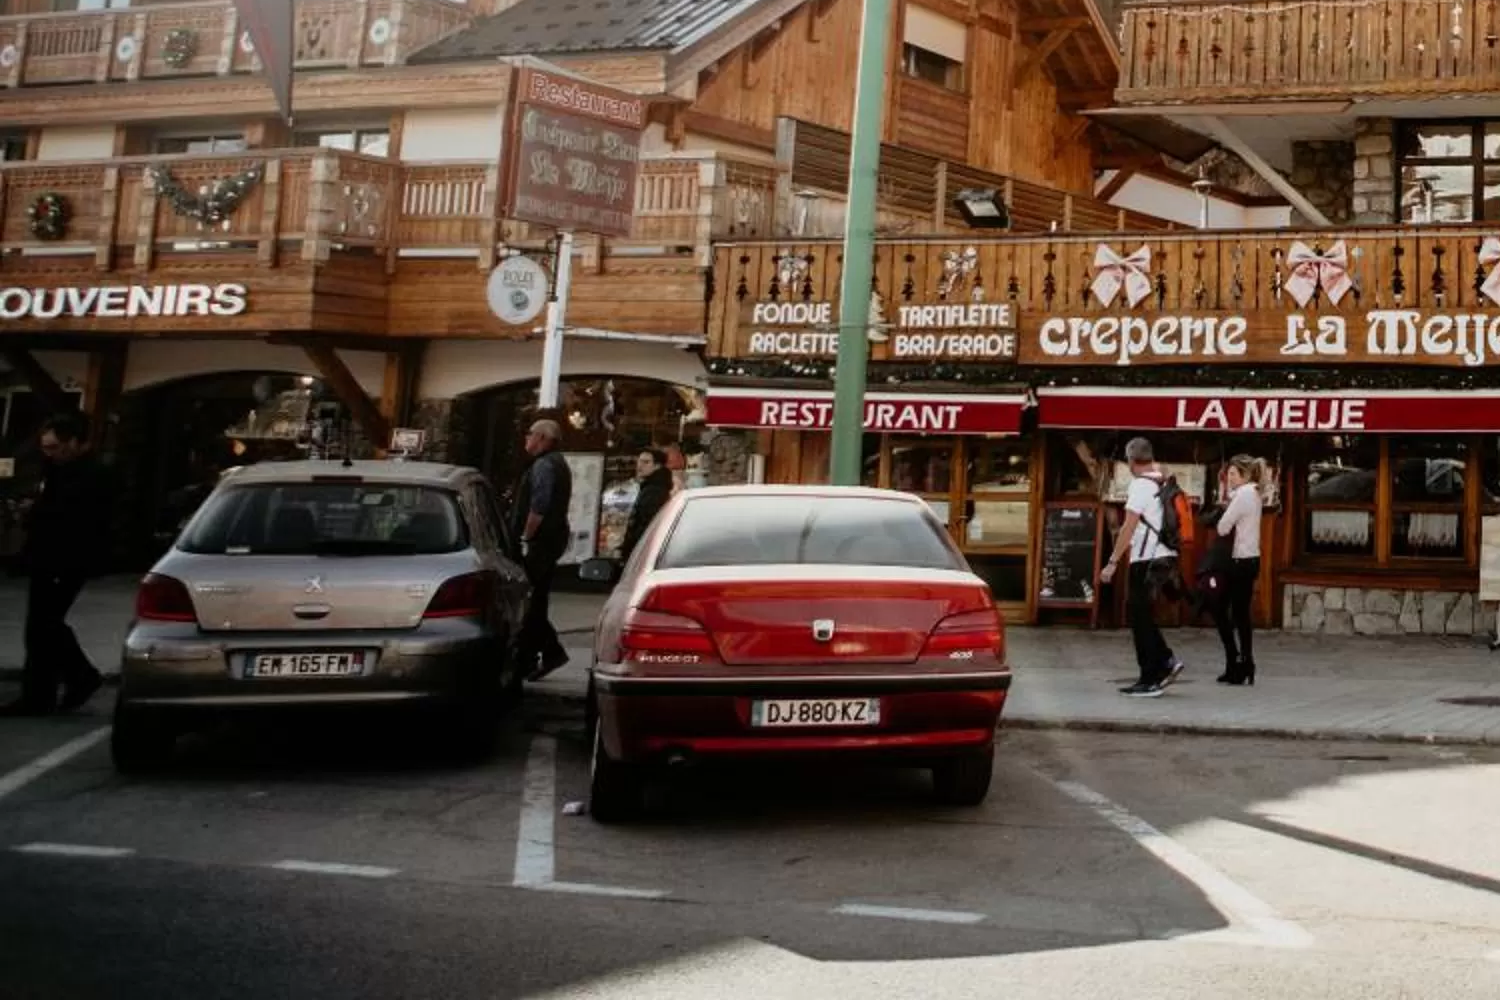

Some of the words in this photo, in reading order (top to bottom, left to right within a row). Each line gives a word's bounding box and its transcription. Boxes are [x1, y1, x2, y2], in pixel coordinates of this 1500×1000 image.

[530, 72, 641, 125] Restaurant
[753, 302, 831, 325] FONDUE
[899, 304, 1010, 327] TARTIFLETTE
[750, 331, 839, 354] RACLETTE
[895, 334, 1016, 357] BRASERADE
[1280, 313, 1347, 356] La
[760, 401, 963, 430] RESTURANT
[1175, 399, 1229, 429] LA
[1242, 399, 1367, 430] MEIJE
[767, 701, 868, 724] DJ-880-KZ
